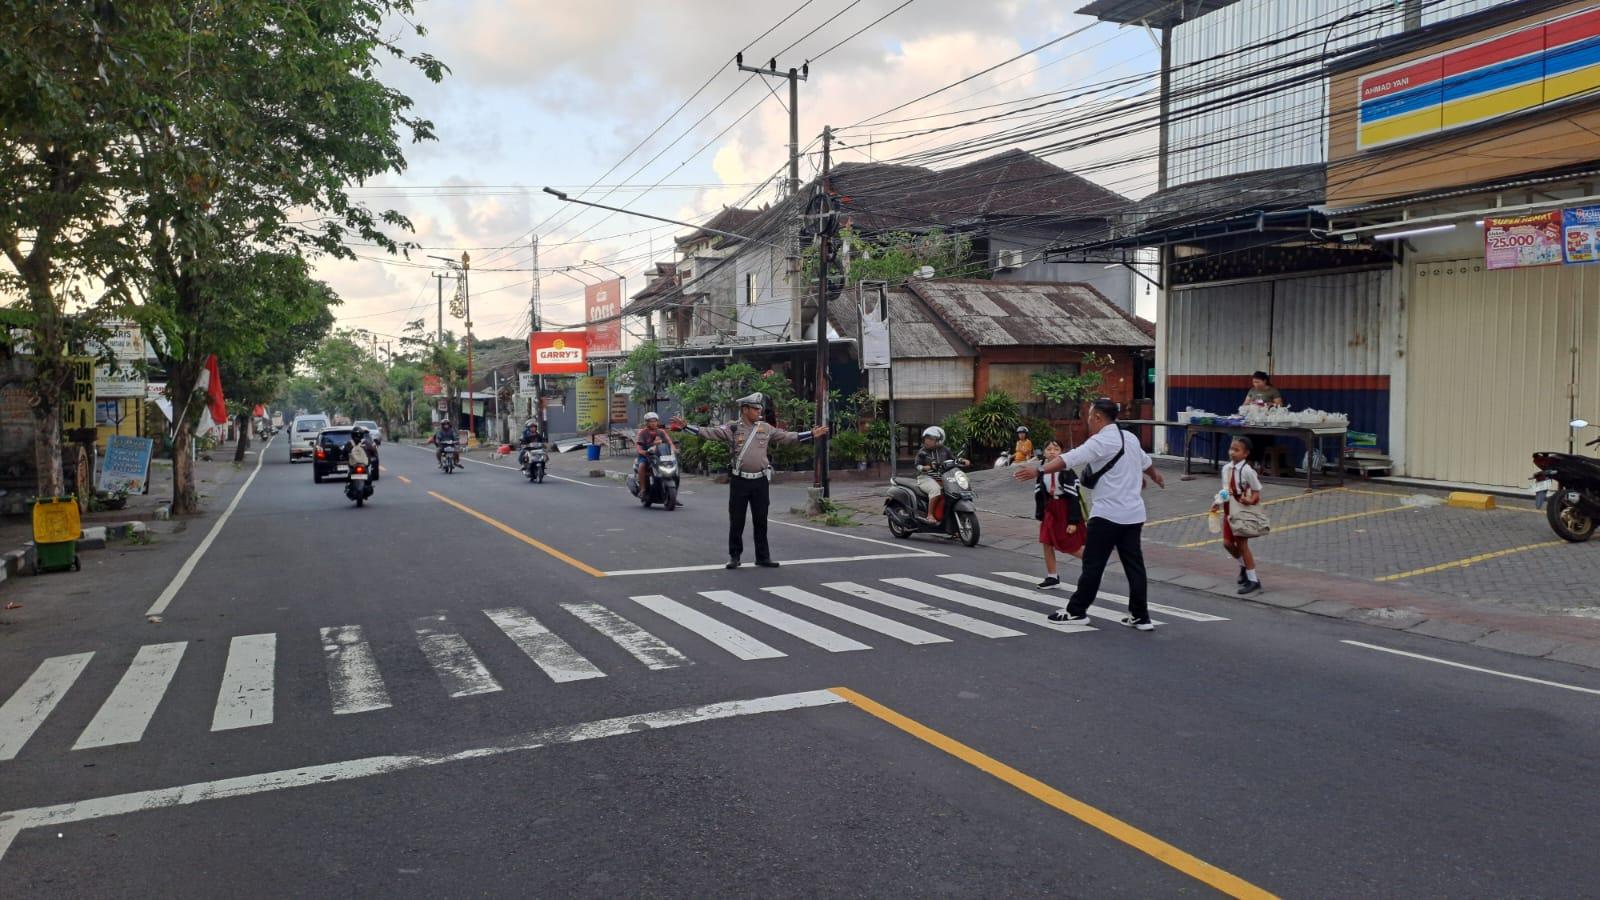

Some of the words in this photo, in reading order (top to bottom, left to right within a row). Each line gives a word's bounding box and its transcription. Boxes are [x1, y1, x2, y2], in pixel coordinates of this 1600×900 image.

[1365, 82, 1391, 95] AHMAD
[1392, 77, 1409, 88] YANI
[1492, 234, 1535, 249] 25.000
[540, 351, 579, 359] GARRY'S
